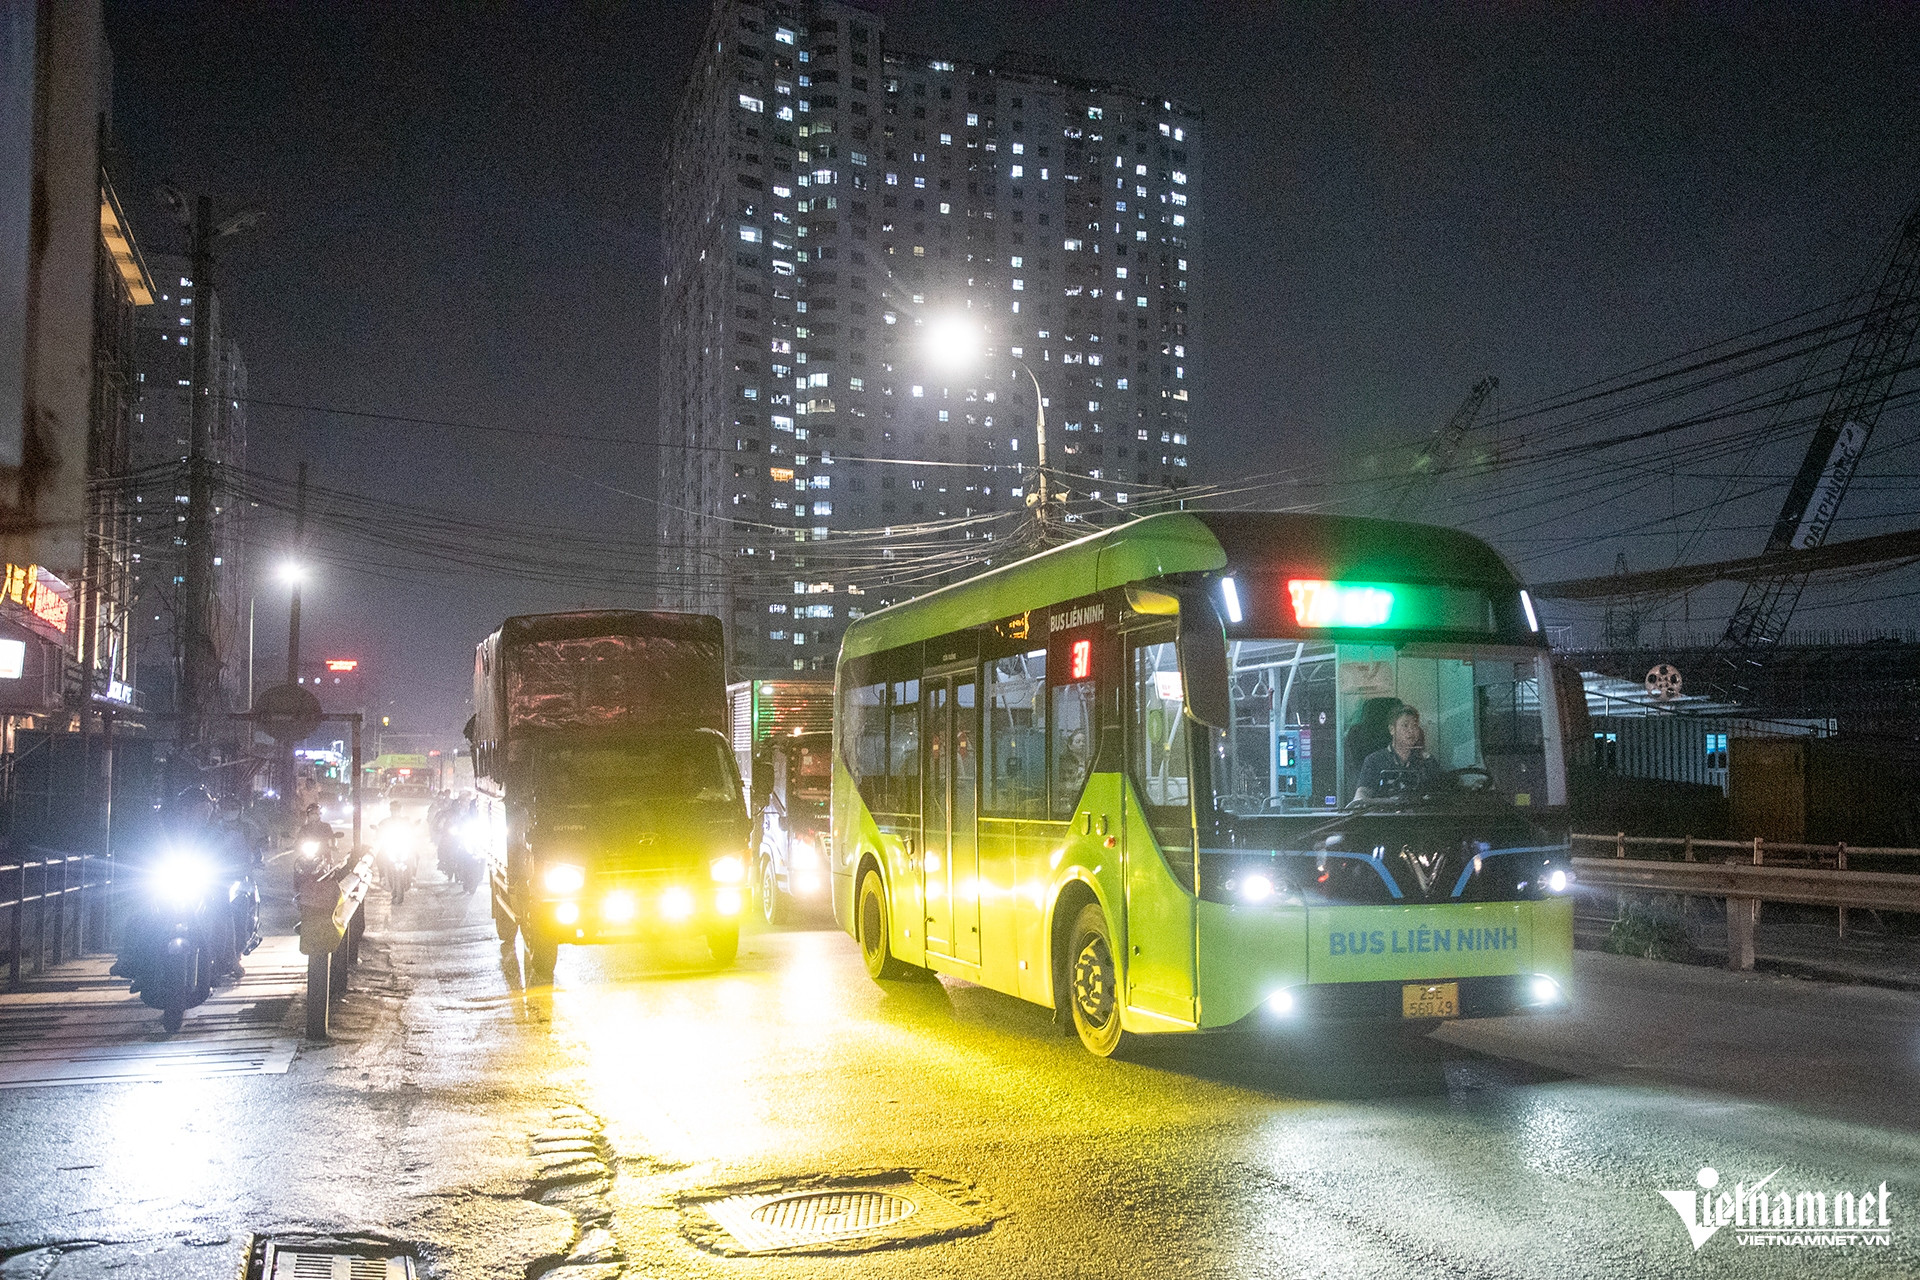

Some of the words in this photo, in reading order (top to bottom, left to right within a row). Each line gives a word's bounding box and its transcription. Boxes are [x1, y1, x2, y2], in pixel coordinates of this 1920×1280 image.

[1050, 612, 1065, 632] BUS
[1065, 606, 1084, 629] LIÊN
[1083, 603, 1105, 625] NINH
[1073, 640, 1091, 679] 37
[1329, 930, 1385, 956] BUS
[1391, 923, 1451, 954] LIÊN
[1456, 926, 1518, 952] NINH
